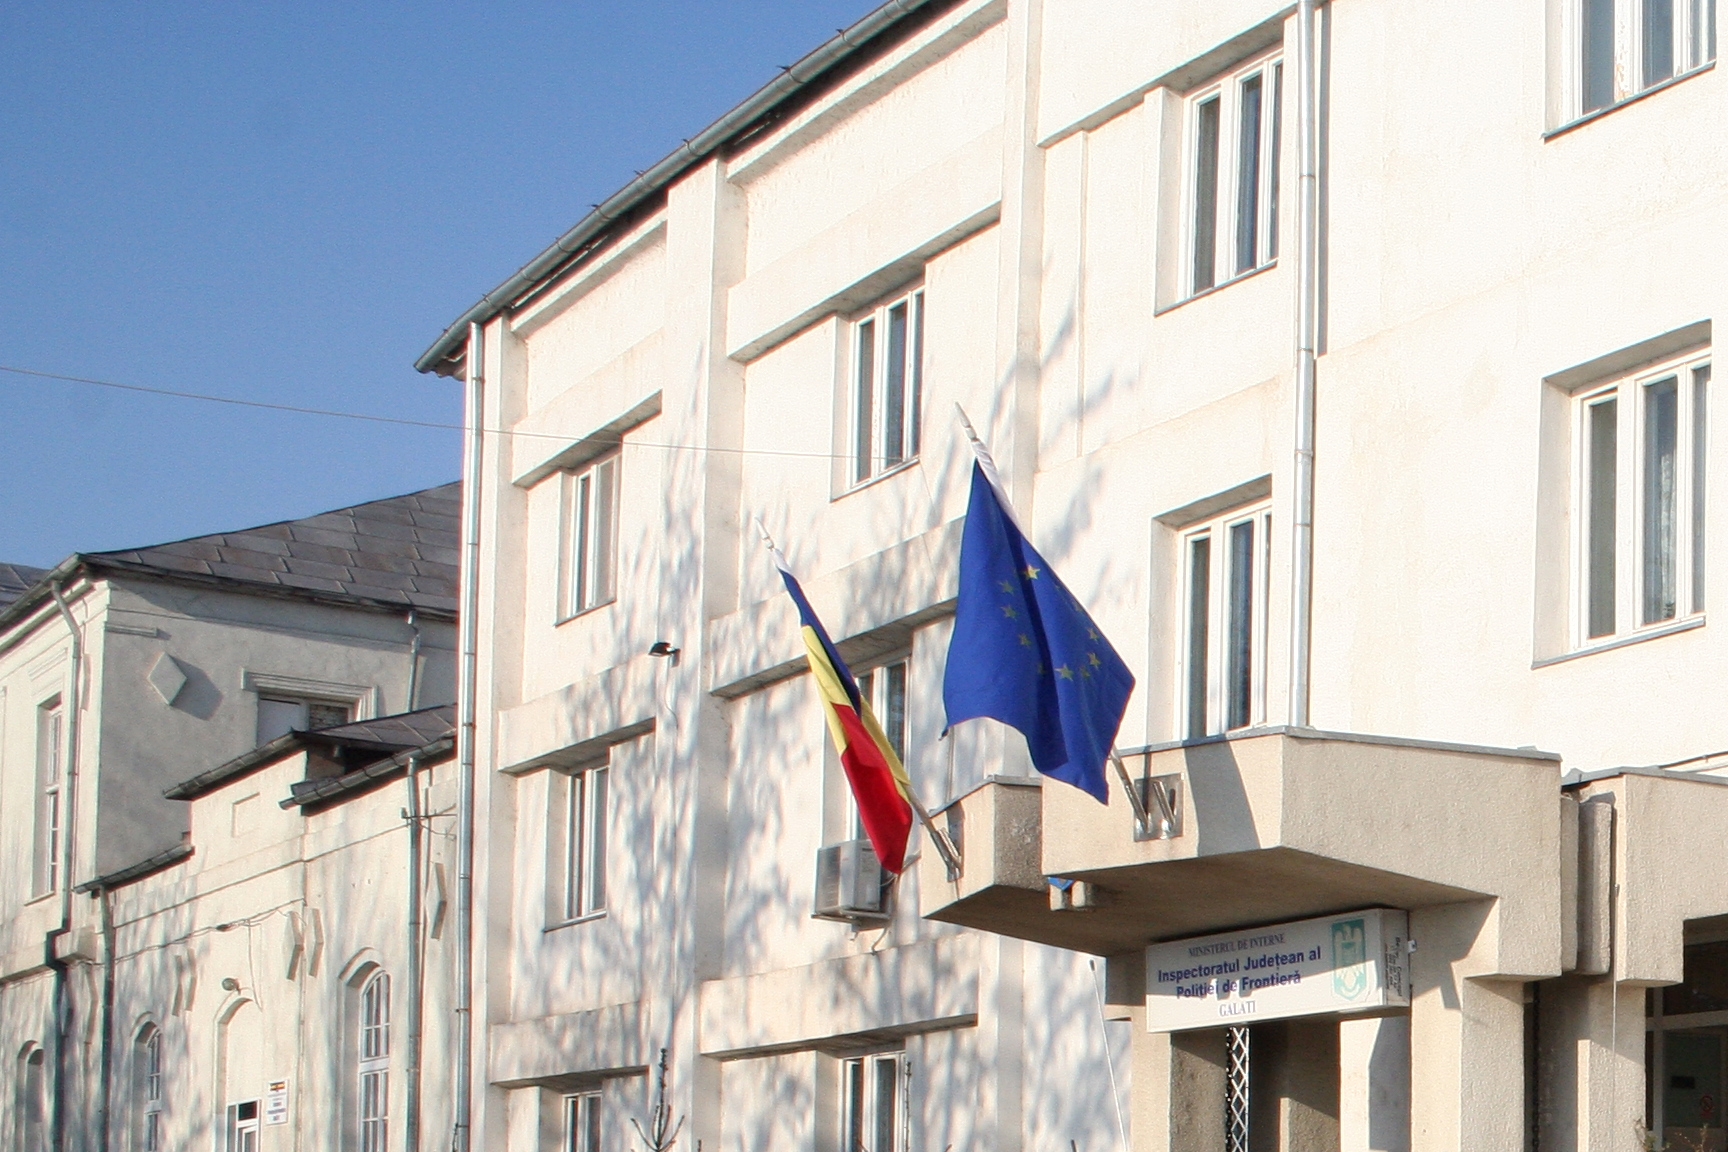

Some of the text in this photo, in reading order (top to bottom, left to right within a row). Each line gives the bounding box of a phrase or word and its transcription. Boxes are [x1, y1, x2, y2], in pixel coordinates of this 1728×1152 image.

[1188, 933, 1286, 957] MINISTERUL DE INTERNE
[1157, 958, 1240, 984] Inspectoratul
[1308, 945, 1322, 962] al
[1222, 978, 1238, 993] de
[1241, 970, 1302, 991] Frontieră
